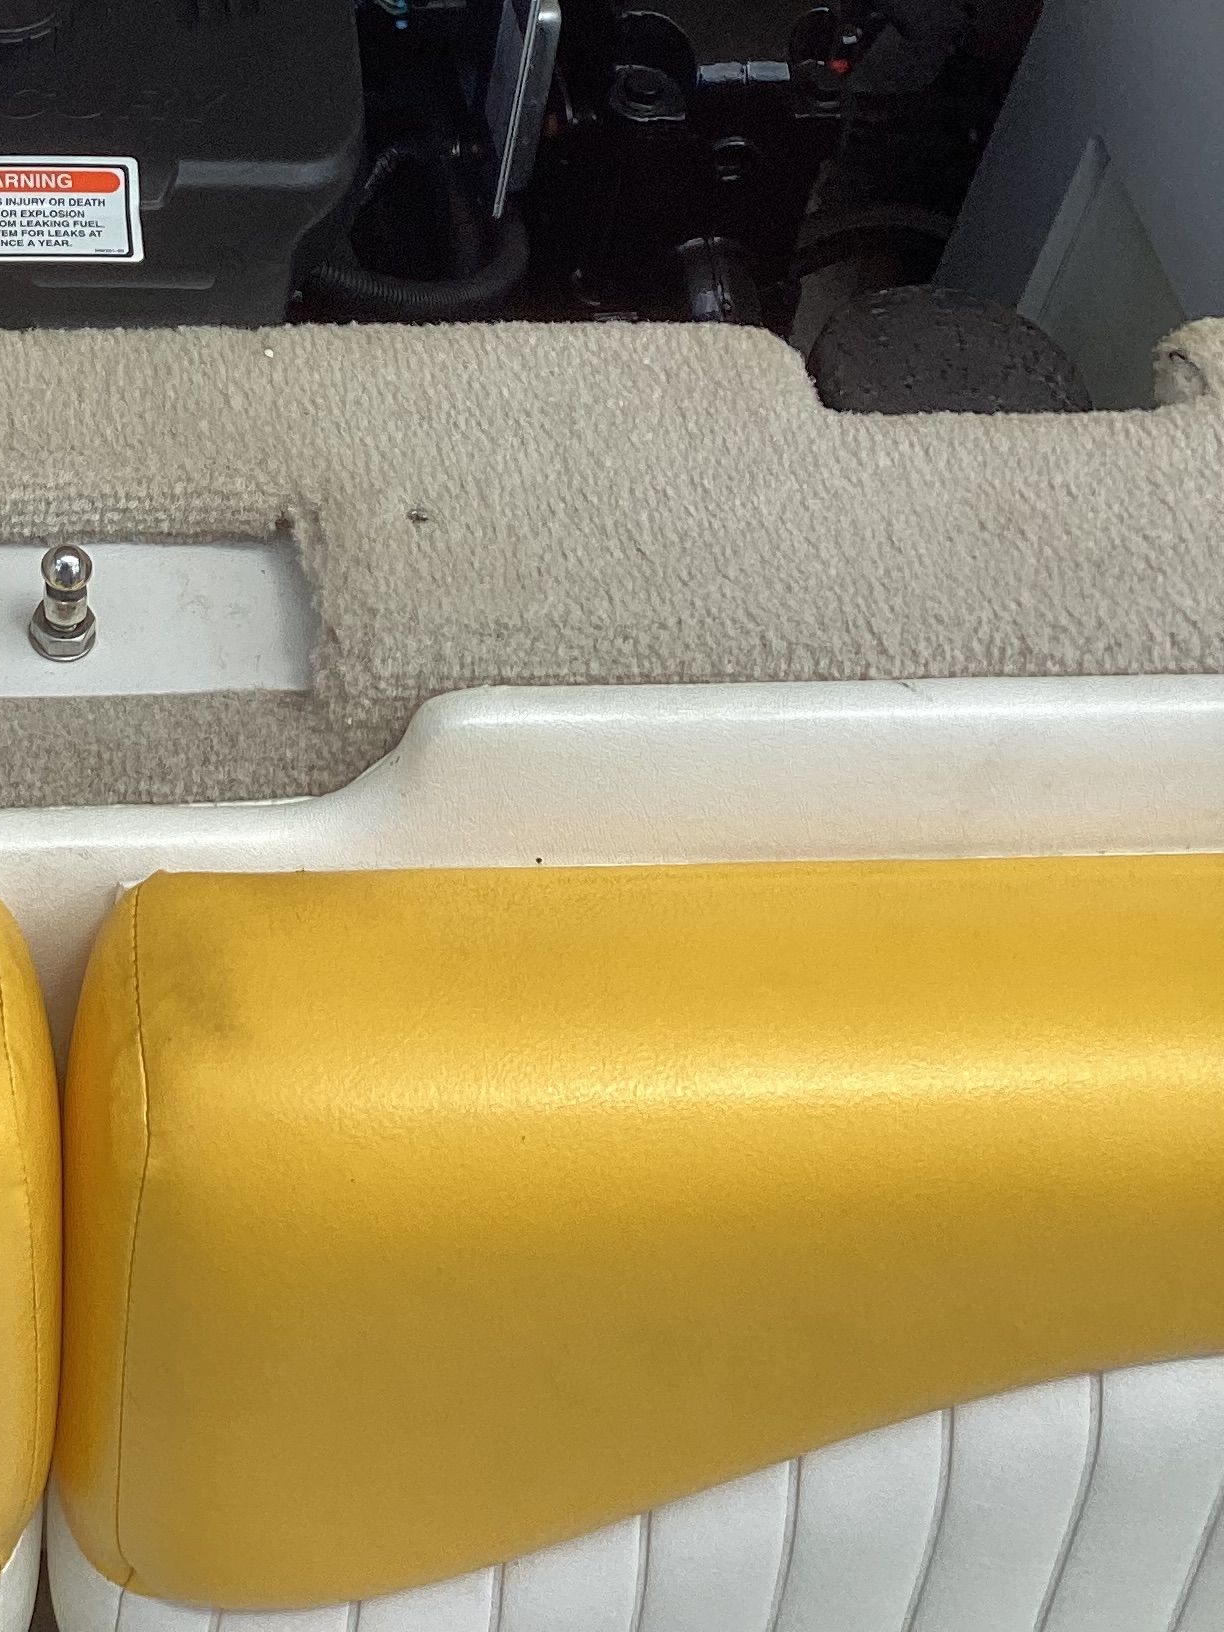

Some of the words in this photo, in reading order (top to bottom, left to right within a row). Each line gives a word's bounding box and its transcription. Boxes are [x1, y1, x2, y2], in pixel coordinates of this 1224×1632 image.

[5, 197, 47, 207] INJURY
[48, 197, 65, 207] OR
[68, 197, 106, 207] DEATH
[0, 209, 17, 218] OR
[20, 209, 85, 218] EXPLOSION
[19, 220, 70, 229] LEAKING
[72, 220, 106, 229] FUEL.
[21, 229, 44, 238] FOR
[47, 229, 86, 238] LEAKS
[88, 229, 103, 238] AT
[27, 239, 36, 248] A
[37, 239, 73, 248] YEAR.
